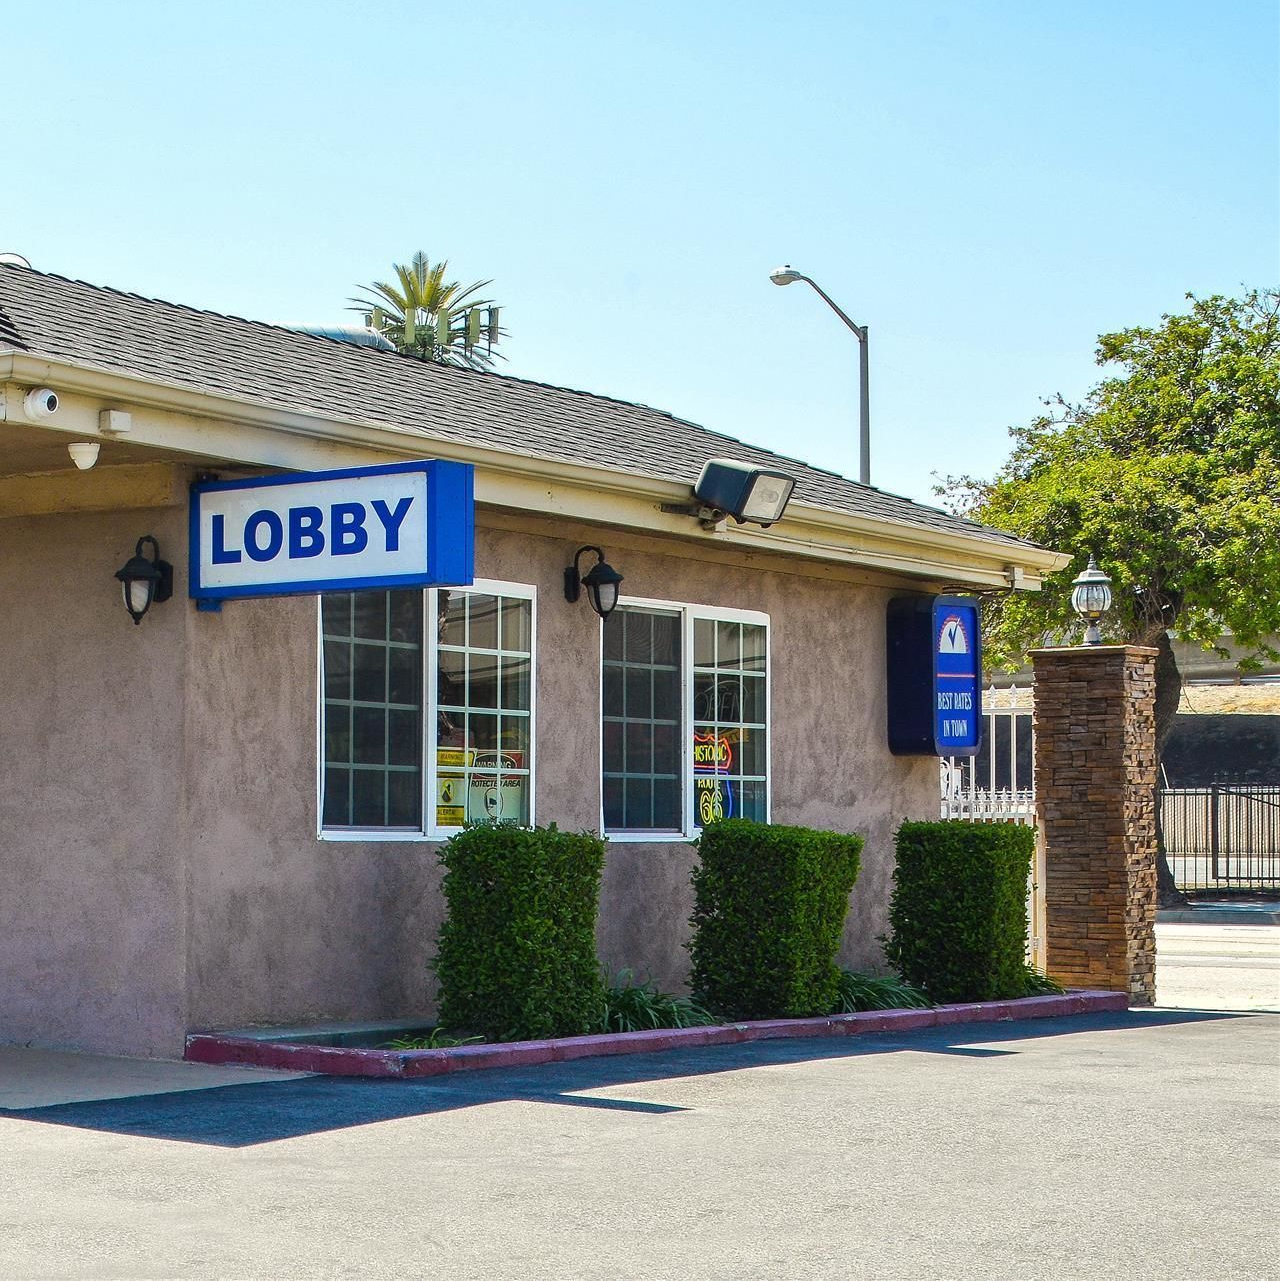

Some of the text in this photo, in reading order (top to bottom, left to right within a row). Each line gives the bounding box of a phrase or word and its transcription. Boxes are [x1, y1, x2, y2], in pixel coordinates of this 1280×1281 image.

[211, 496, 415, 566] LOBBY
[937, 692, 972, 710] BEST RATES
[943, 719, 968, 737] IN TOWN
[694, 744, 727, 762] HISTOIC
[502, 780, 521, 788] AREA
[700, 790, 723, 825] 66
